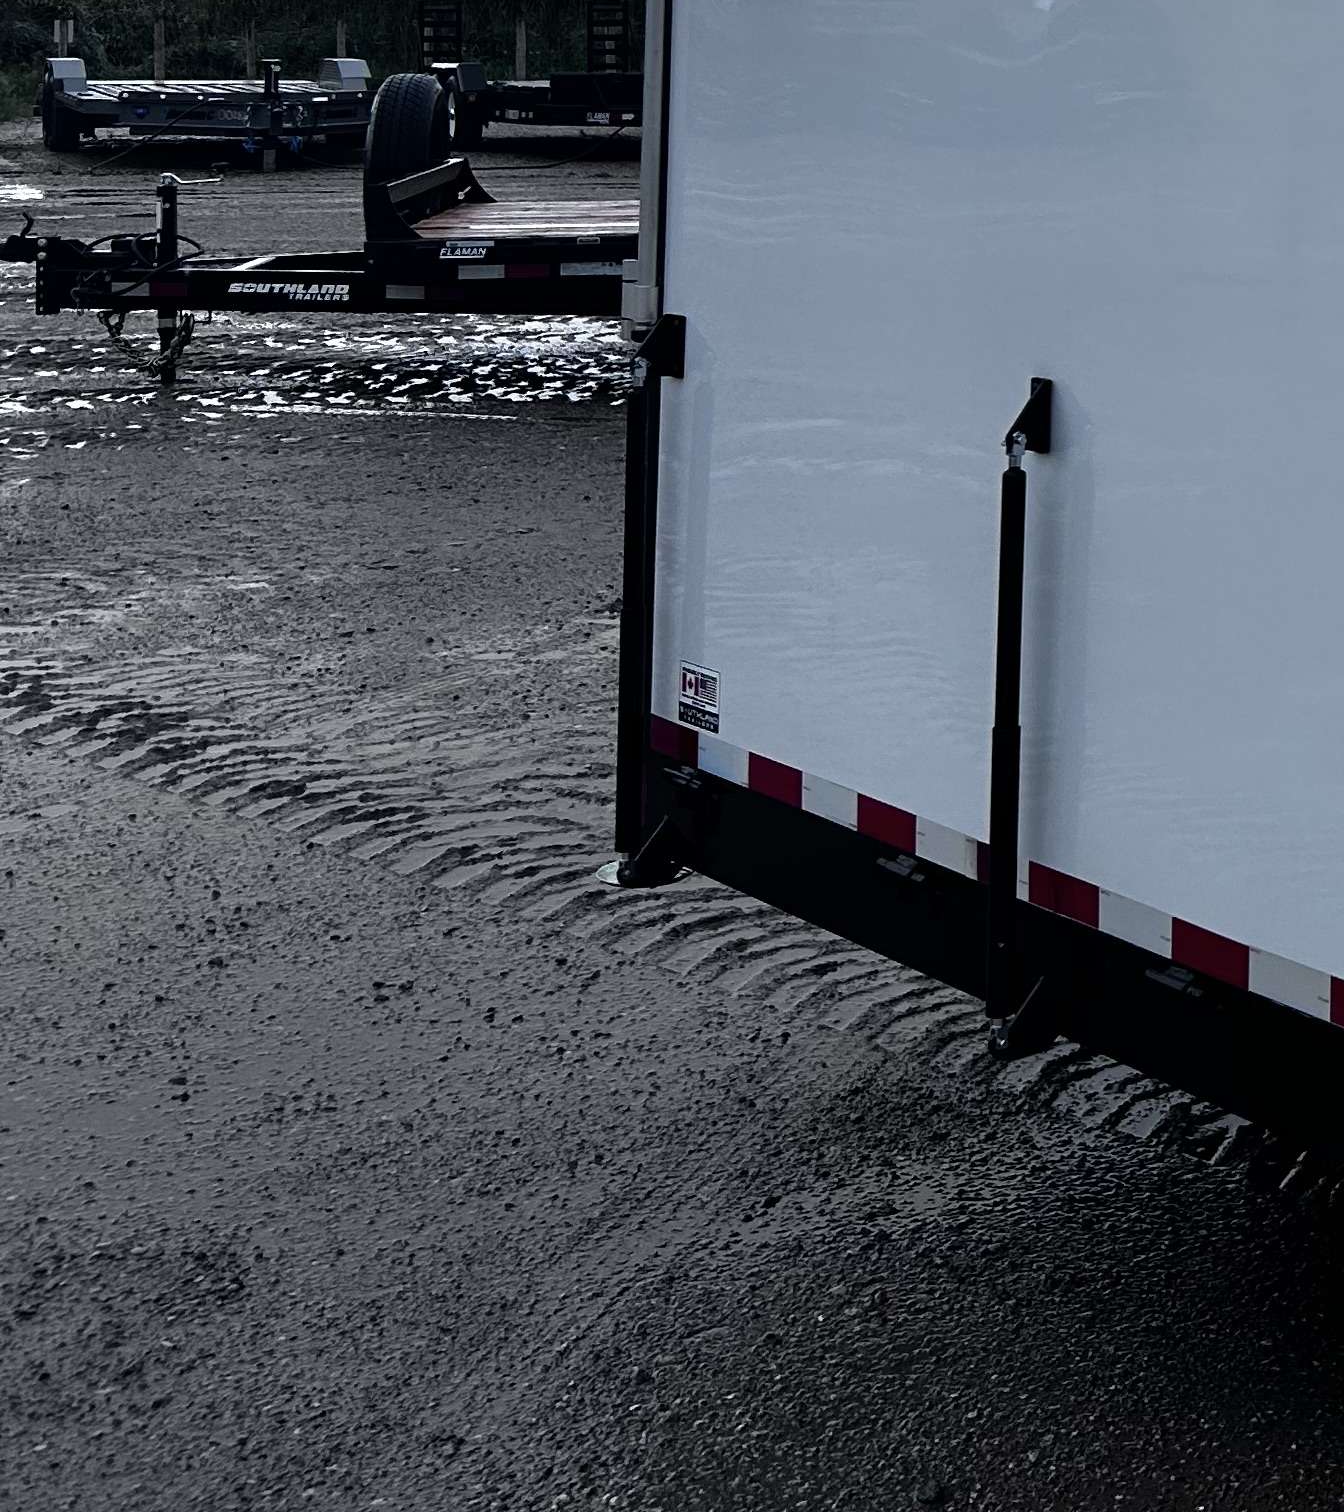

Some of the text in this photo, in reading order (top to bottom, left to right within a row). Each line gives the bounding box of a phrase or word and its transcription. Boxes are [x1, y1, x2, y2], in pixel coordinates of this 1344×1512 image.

[440, 248, 487, 256] FLAMAN
[228, 283, 350, 294] SOUTHLAND
[288, 293, 350, 301] TRAILERS
